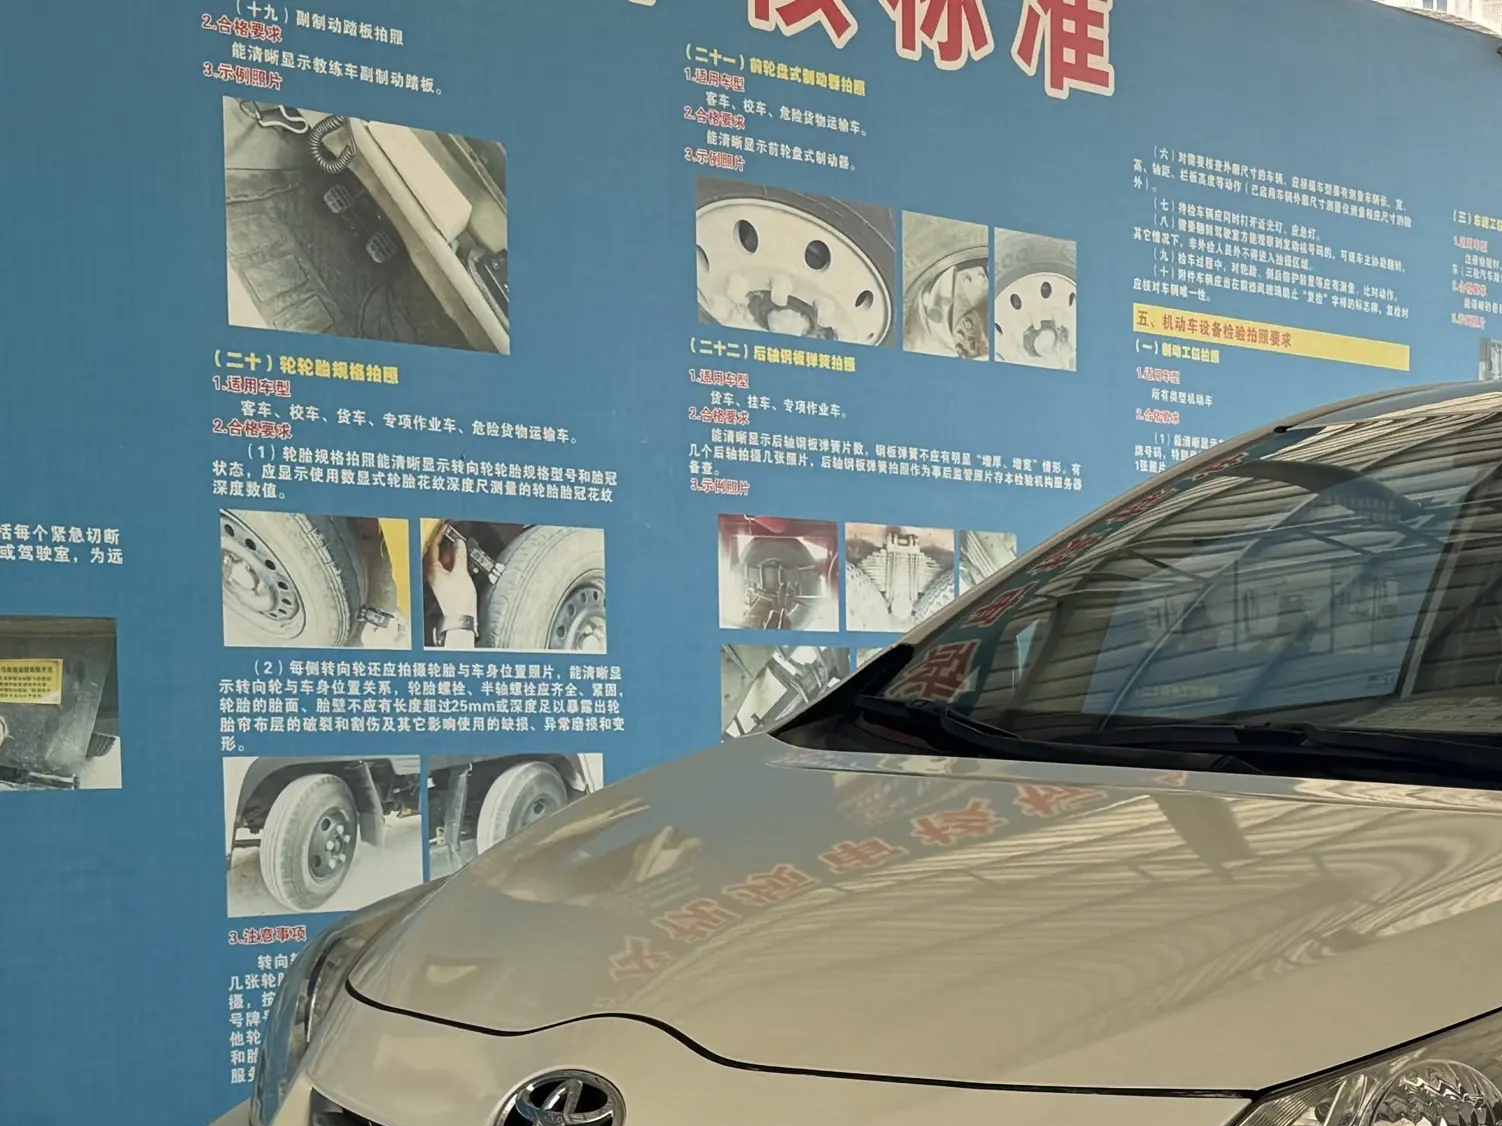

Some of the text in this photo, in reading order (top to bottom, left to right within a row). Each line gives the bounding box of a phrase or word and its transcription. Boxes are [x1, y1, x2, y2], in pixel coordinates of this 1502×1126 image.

[201, 13, 283, 43] 2.合格要求
[203, 62, 283, 91] 3.示例照片
[232, 41, 442, 95] 能清晰显示教练车副制动踏板。
[684, 67, 746, 93] 1.适用车型
[683, 106, 746, 131] 2.合格要求
[706, 91, 867, 136] 客车、校车、危险货物运输车。
[684, 147, 746, 172] 3.示例照片
[706, 130, 856, 171] 能清晰显示前轮盘式制动器。
[1136, 309, 1292, 348] 五、机动车设备检验拍照要求
[214, 349, 399, 384] （二十）轮轮胎规格拍照
[690, 337, 856, 372] （二十二）后轴钢板弹簧拍照
[212, 375, 291, 397] 1.适用车型
[689, 369, 749, 389] 1.适用车型
[688, 406, 750, 425] 2.合格要求
[710, 390, 847, 419] 货车、挂车、专项作业车。
[212, 419, 292, 439] 2.合格要求
[241, 400, 577, 444] 客车、校车、货车、专项作业车、危险货物运输车。
[248, 445, 618, 486] （1）轮胎规格拍照能清晰显示转向轮轮胎规格型号和胎冠
[689, 460, 720, 477] 备查。
[212, 460, 613, 503] 状态，应显示使用数显式轮胎花纹深度尺测量的轮胎胎冠花纹
[212, 480, 286, 500] 深度数值。
[690, 478, 750, 496] 3.示例照片
[0, 544, 123, 565] 或驾驶室，为远
[254, 660, 622, 681] （2）每侧转向轮还应拍摄轮胎与车身位置照片，能清晰显
[219, 697, 620, 715] 轮胎的胎面、胎壁不应有长度超过25mm或深度足以暴露出轮
[220, 736, 246, 752] 形。
[228, 925, 307, 945] 3.注意事项
